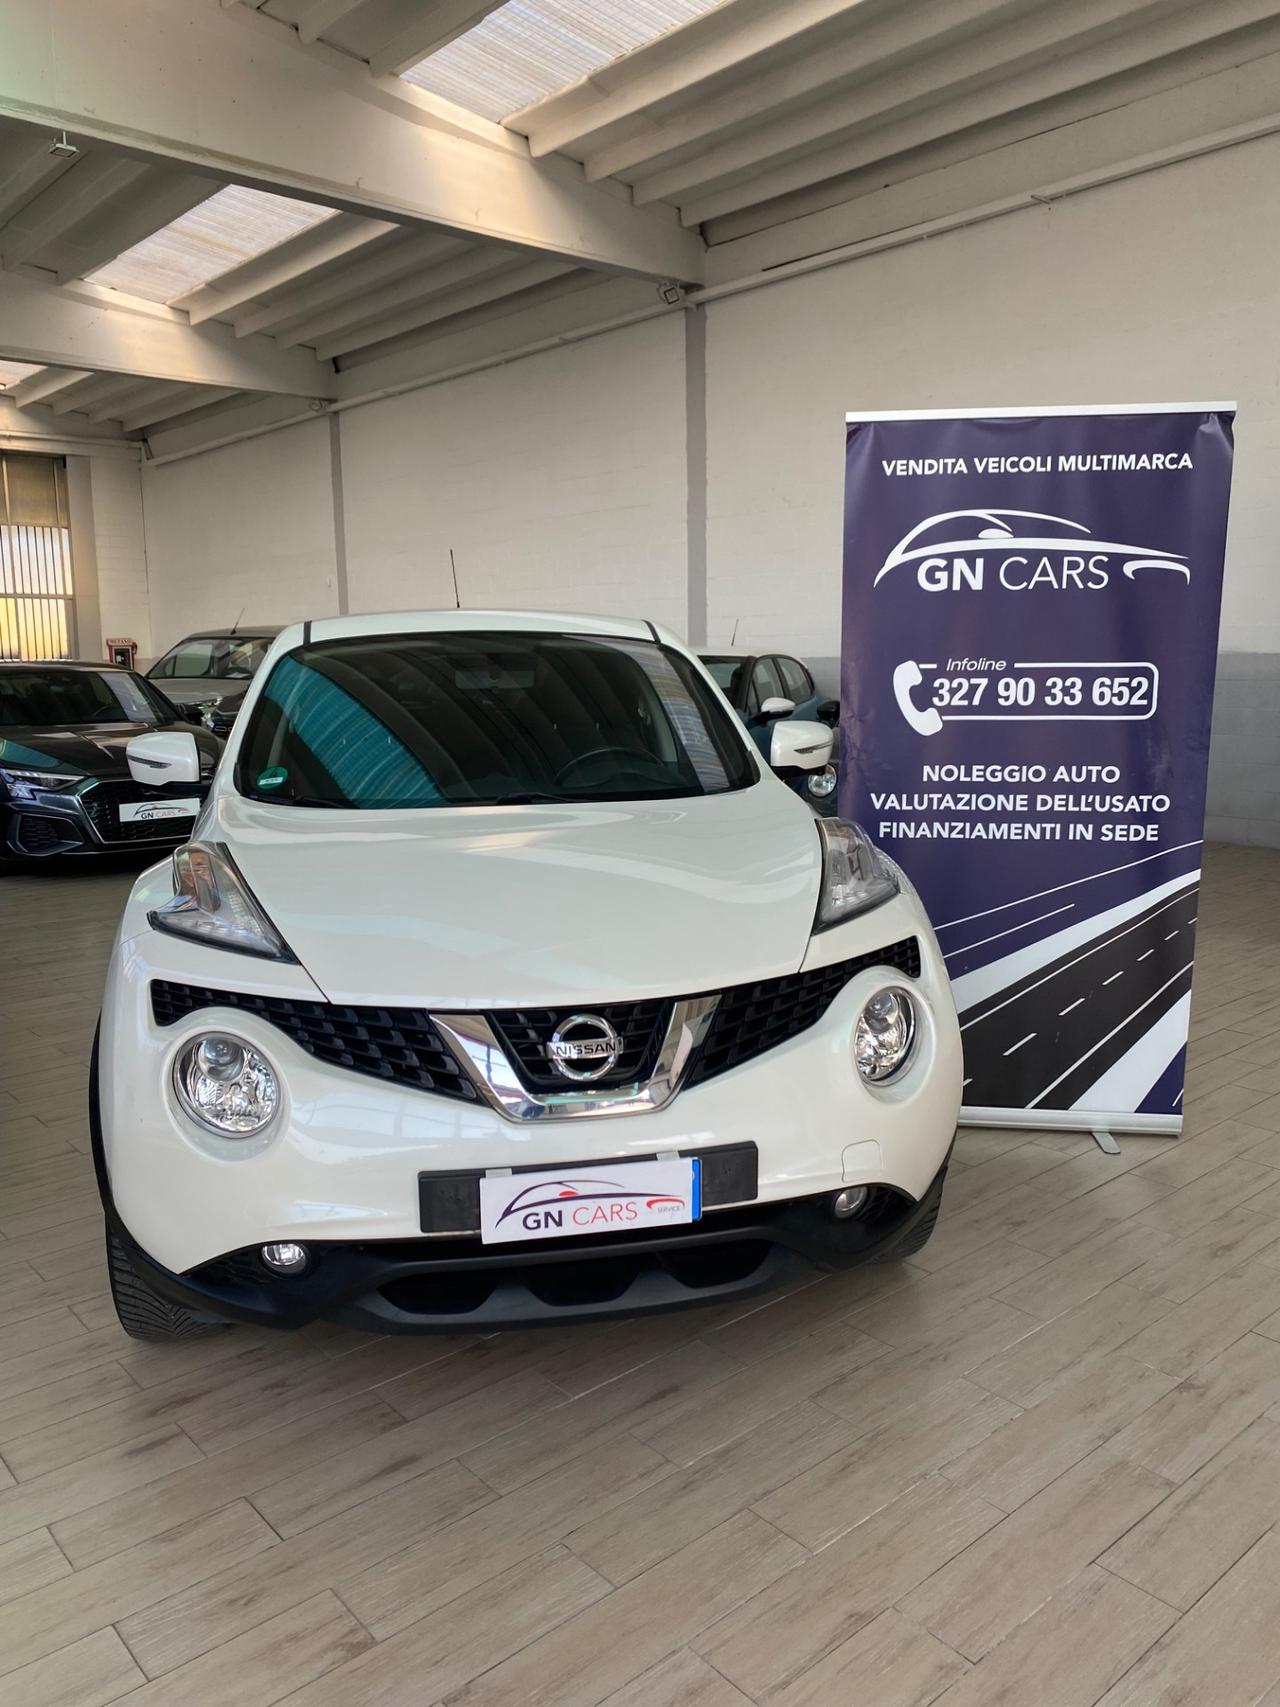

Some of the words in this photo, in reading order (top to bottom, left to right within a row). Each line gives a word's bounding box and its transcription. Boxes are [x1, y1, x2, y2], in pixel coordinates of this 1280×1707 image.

[882, 458, 968, 476] VENDITA
[974, 455, 1052, 474] VEICOLI
[1057, 453, 1193, 472] MULTIMARCA
[917, 556, 984, 591] GN
[999, 555, 1109, 591] CARS
[946, 658, 1007, 672] Infoline
[932, 677, 988, 707] 327
[997, 677, 1035, 706] 90
[1045, 677, 1083, 706] 33
[1092, 676, 1148, 706] 652
[922, 764, 1046, 783] NOLEGGIO
[1053, 765, 1121, 784] AUTO
[870, 793, 1028, 811] VALUTAZIONE
[879, 822, 1061, 840] FINANZIAMENTI
[1068, 823, 1094, 841] IN
[1100, 824, 1159, 842] SEDE
[556, 1042, 617, 1056] NISSAN
[522, 1209, 563, 1230] GN
[572, 1202, 638, 1225] CARS
